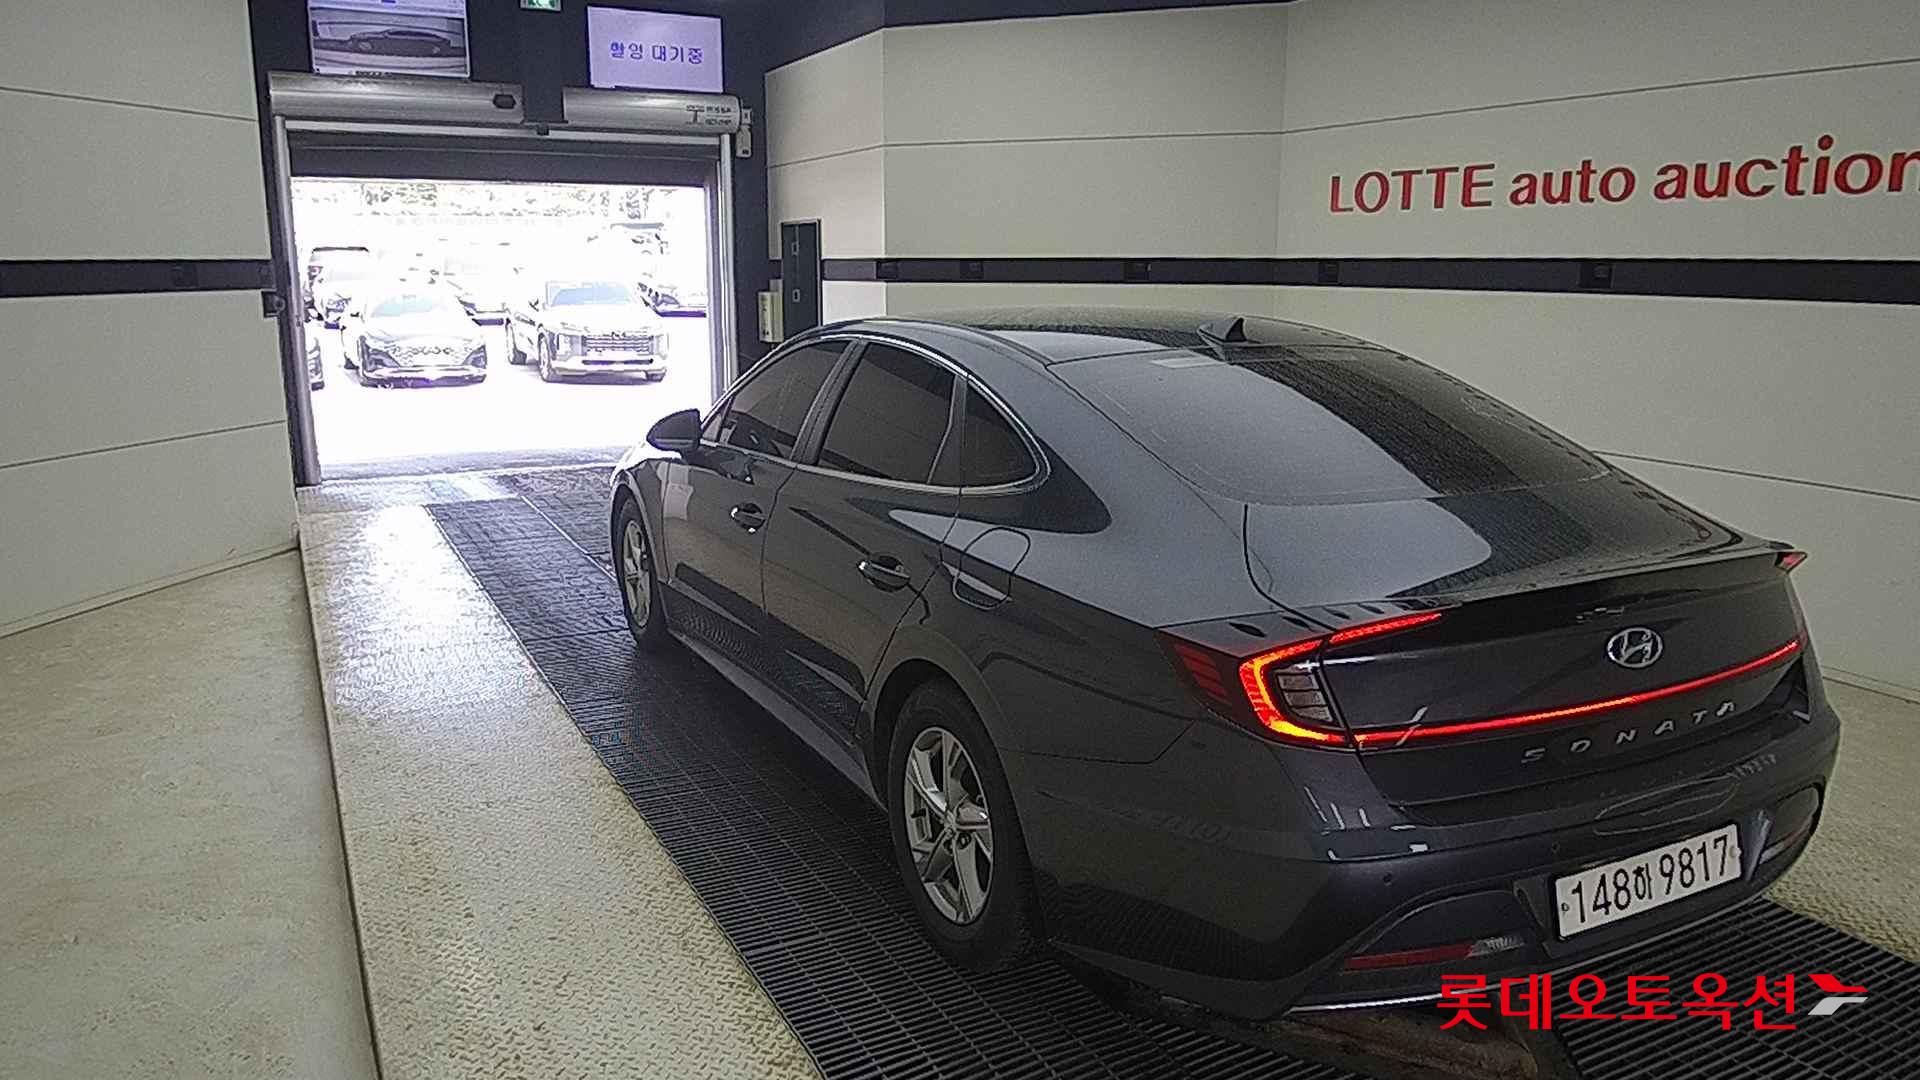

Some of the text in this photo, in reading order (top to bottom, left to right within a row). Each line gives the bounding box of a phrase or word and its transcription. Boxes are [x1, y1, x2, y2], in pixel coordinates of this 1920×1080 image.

[651, 45, 703, 65] 대기중
[1329, 133, 1920, 213] LOTTE auto auction
[1521, 700, 1736, 764] SONATA
